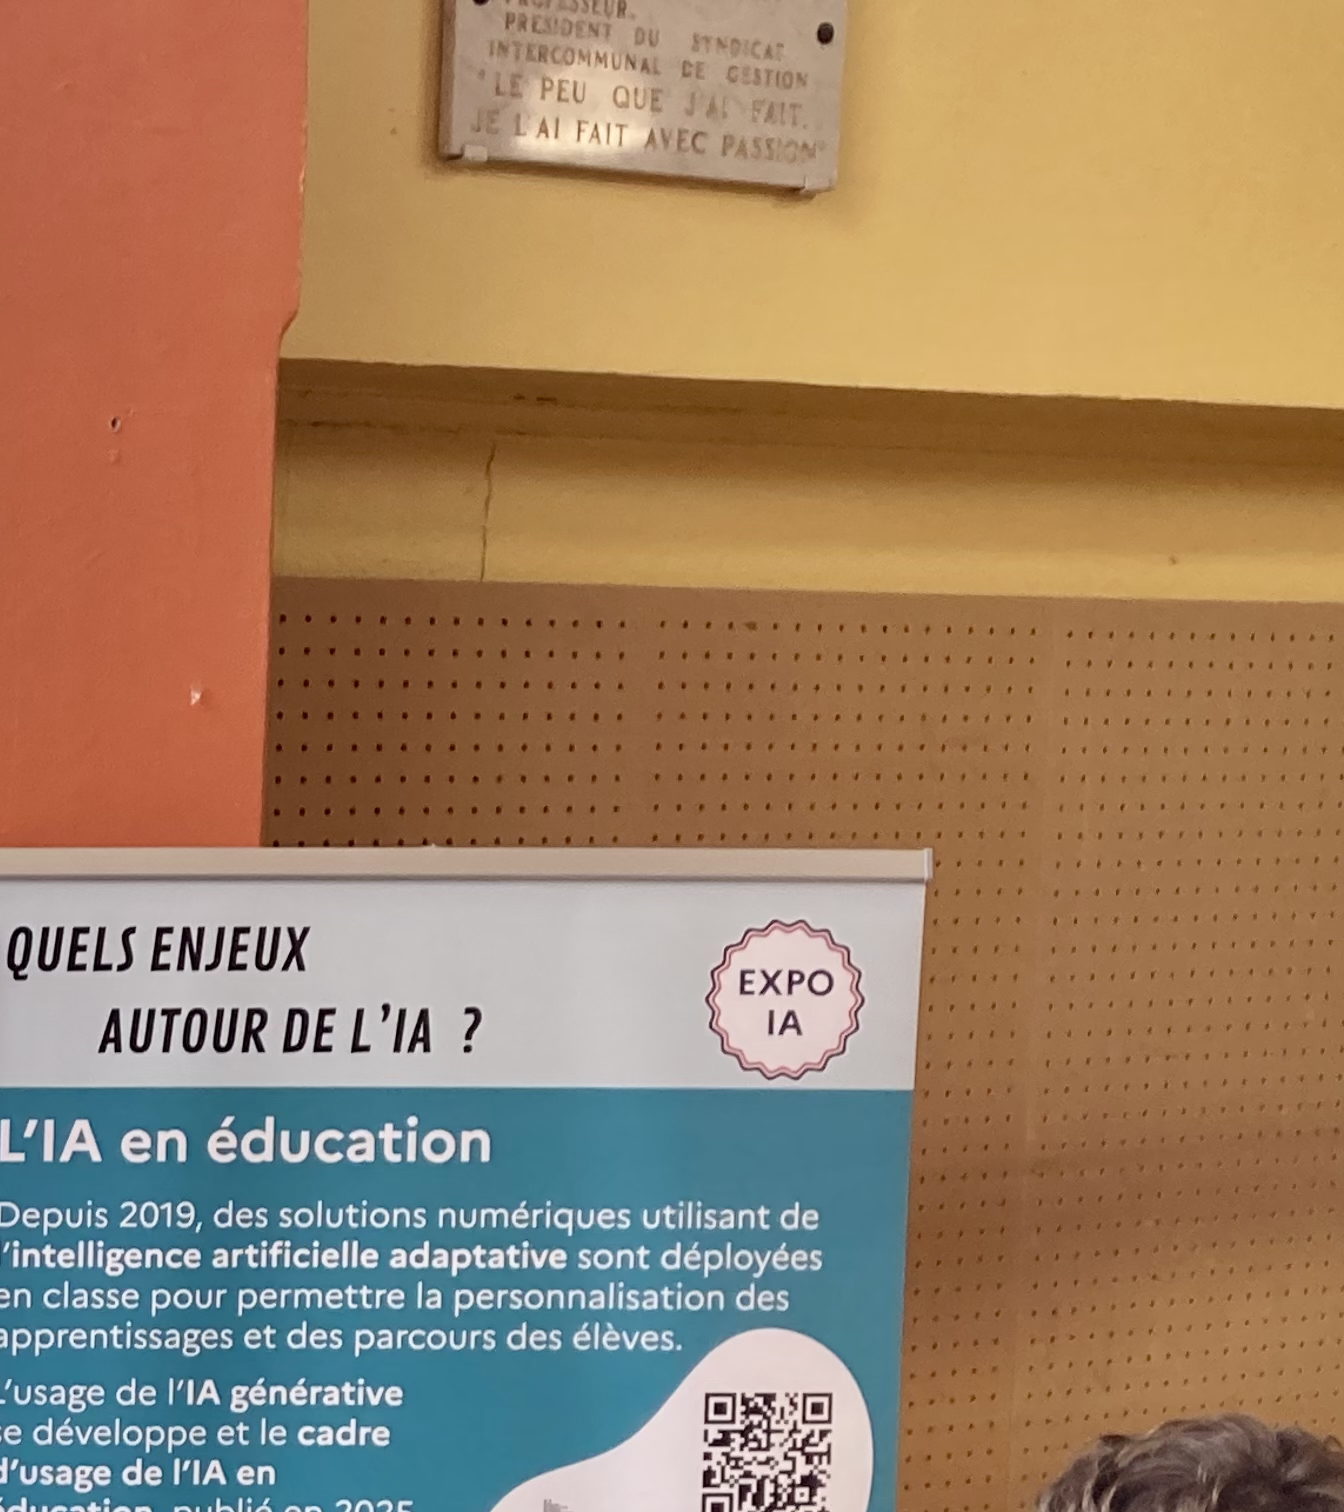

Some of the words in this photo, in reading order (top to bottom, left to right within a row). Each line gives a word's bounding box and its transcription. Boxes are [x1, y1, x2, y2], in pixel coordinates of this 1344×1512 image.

[634, 26, 660, 48] DU
[681, 60, 705, 80] DE
[540, 78, 586, 104] PEU
[613, 86, 663, 113] QUE
[470, 108, 500, 134] JE
[515, 116, 559, 140] L'AI
[577, 121, 629, 147] FAIT
[644, 128, 709, 154] AVEC
[7, 926, 136, 981] QUELS
[151, 926, 310, 971] ENJEUX
[740, 969, 834, 996] EXPO
[98, 1008, 268, 1053] AUTOUR
[283, 1008, 336, 1053] DE
[351, 1003, 430, 1053] L'IA
[463, 1007, 482, 1053] ?
[768, 1010, 802, 1036] IA
[0, 1119, 102, 1162] L'IA
[121, 1129, 186, 1163] en
[208, 1116, 490, 1163] éducation
[120, 1201, 202, 1233] 2019,
[214, 1200, 268, 1228] des
[279, 1200, 426, 1228] solutions
[439, 1201, 630, 1236] numériques
[643, 1201, 770, 1230] utilisant
[780, 1202, 818, 1230] de
[212, 1240, 378, 1268] artificielle
[390, 1241, 567, 1276] adaptative
[578, 1246, 650, 1269] sont
[661, 1242, 822, 1278] déployées
[43, 1281, 139, 1309] classe
[152, 1289, 227, 1317] pour
[238, 1285, 404, 1316] permettre
[417, 1281, 441, 1309] la
[455, 1282, 724, 1317] personnalisation
[736, 1283, 789, 1311] des
[244, 1325, 276, 1349] et
[287, 1321, 342, 1349] des
[355, 1329, 495, 1357] parcours
[507, 1322, 561, 1350] des
[573, 1322, 682, 1351] élèves.
[116, 1378, 156, 1405] de
[169, 1378, 220, 1405] l'IA
[230, 1378, 403, 1413] générative
[33, 1418, 206, 1453] développe
[217, 1422, 249, 1445] et
[261, 1418, 286, 1445] le
[298, 1419, 390, 1446] cadre
[122, 1458, 162, 1486] de
[174, 1458, 226, 1485] l'IA
[237, 1466, 275, 1485] en
